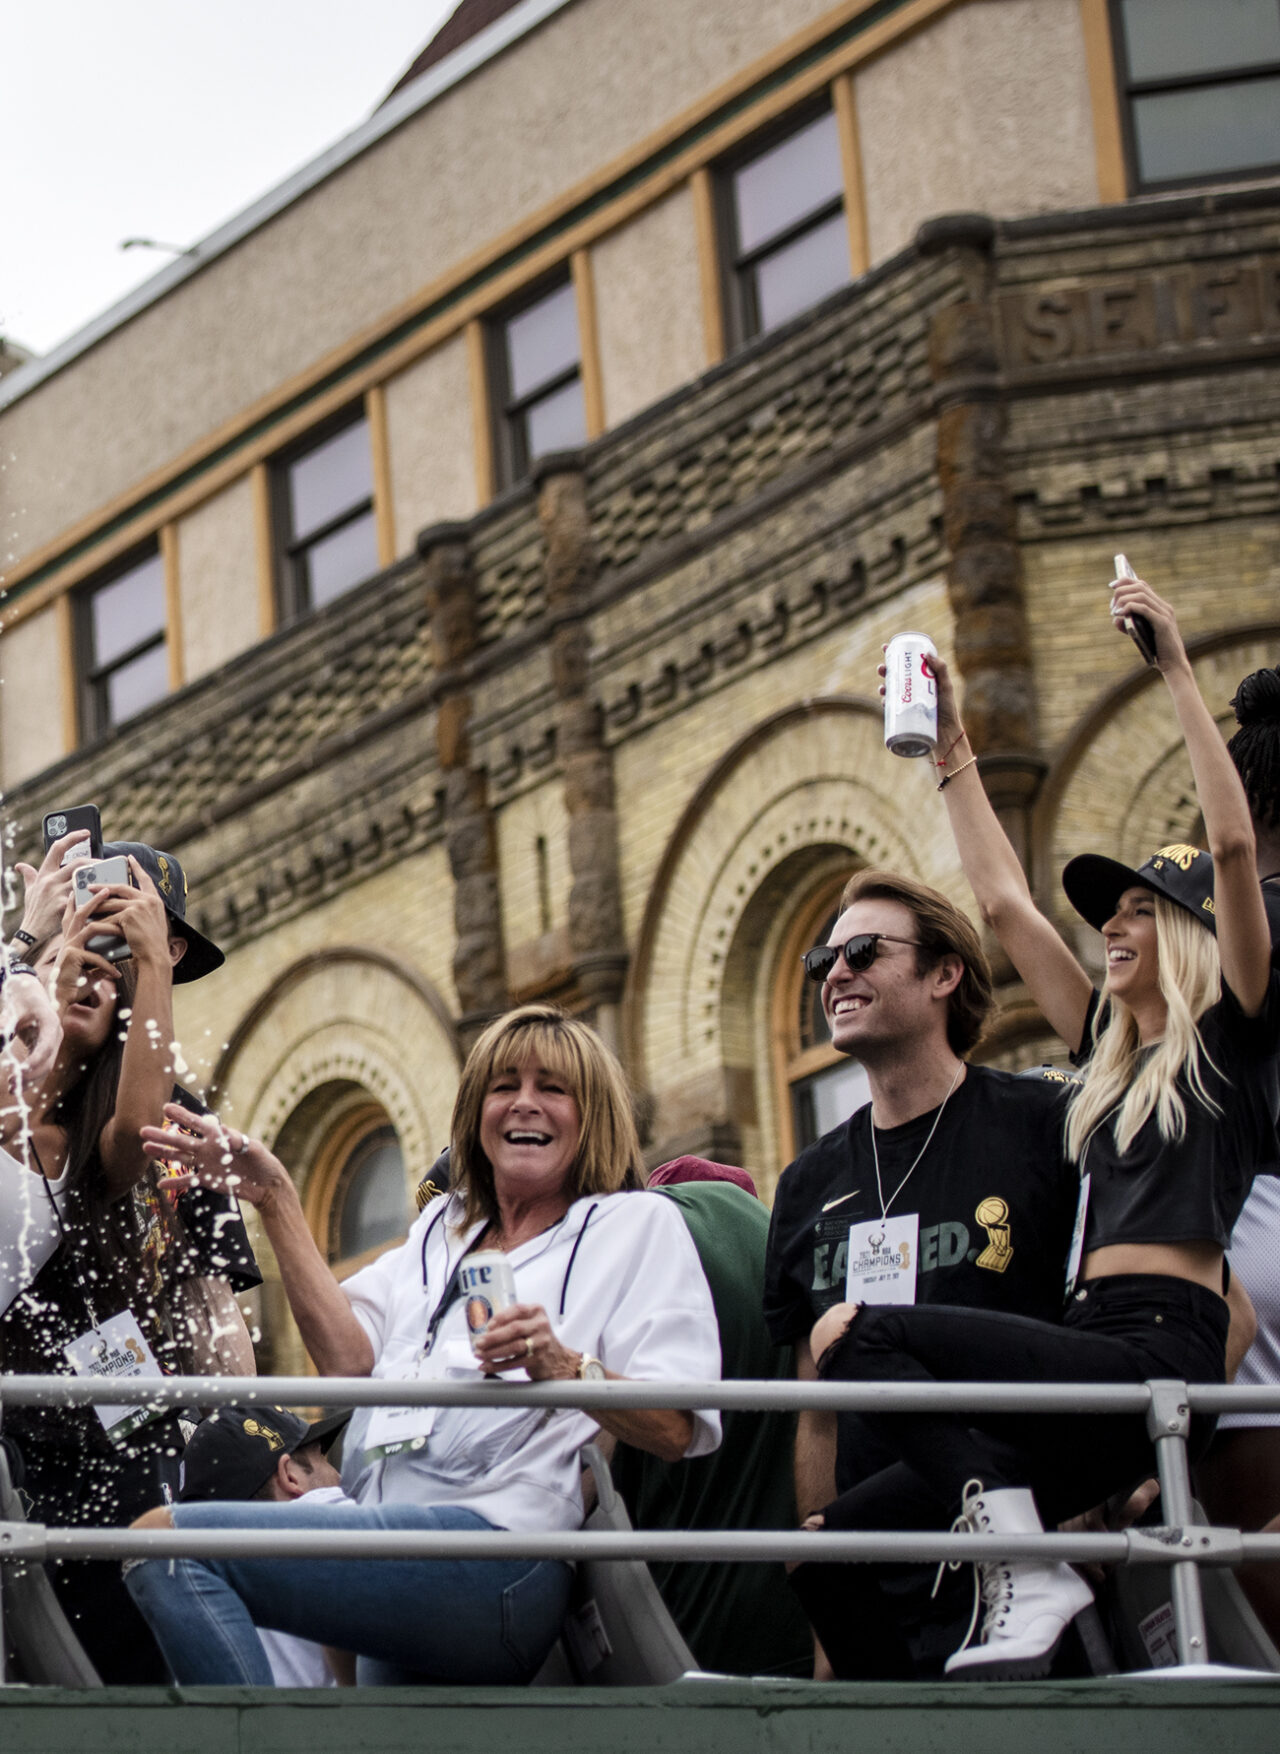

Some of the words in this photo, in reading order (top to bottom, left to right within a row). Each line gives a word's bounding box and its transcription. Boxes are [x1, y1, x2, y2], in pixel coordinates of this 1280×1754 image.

[904, 651, 912, 676] LIGHT
[852, 1253, 901, 1272] CHAMPIONS
[131, 1410, 150, 1427] VIP
[385, 1443, 403, 1454] VIP
